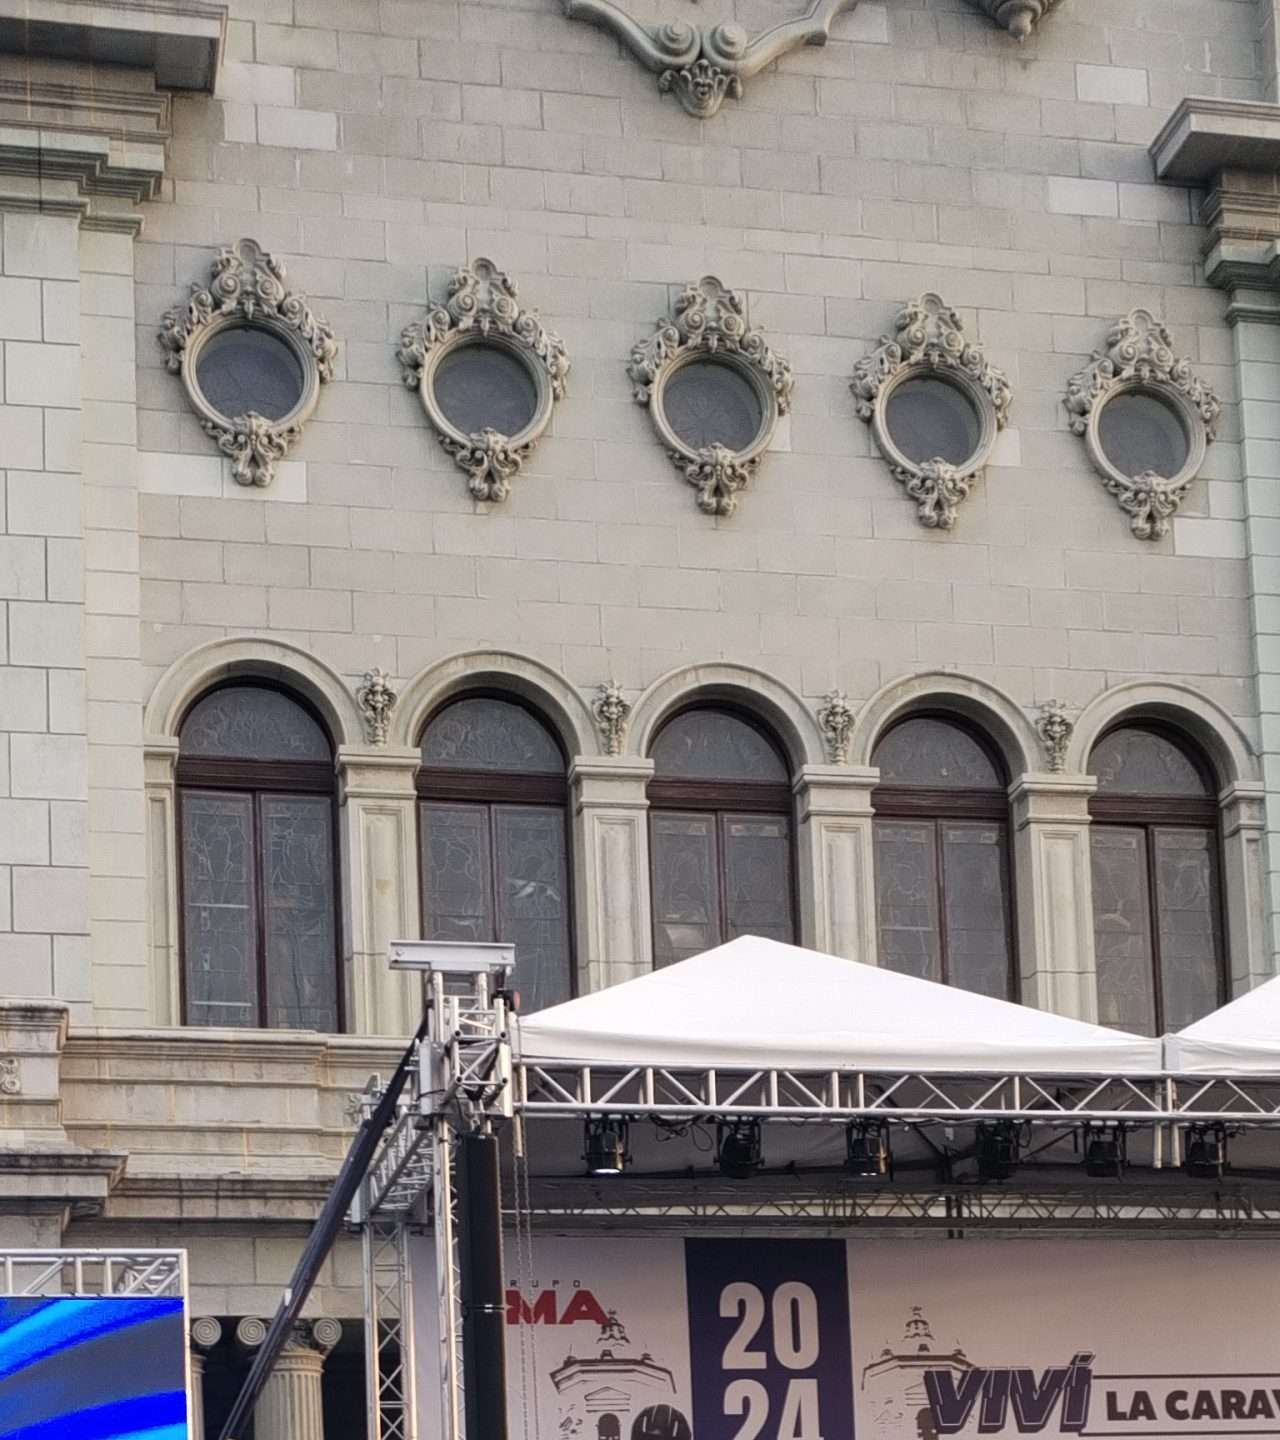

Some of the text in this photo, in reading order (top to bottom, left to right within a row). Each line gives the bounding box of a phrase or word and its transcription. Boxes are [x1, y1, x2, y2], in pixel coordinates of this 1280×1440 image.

[505, 1290, 611, 1325] MA
[510, 1280, 581, 1288] RUPO
[719, 1281, 819, 1369] 20
[923, 1352, 1095, 1434] VIVÍ
[1106, 1390, 1157, 1421] LA
